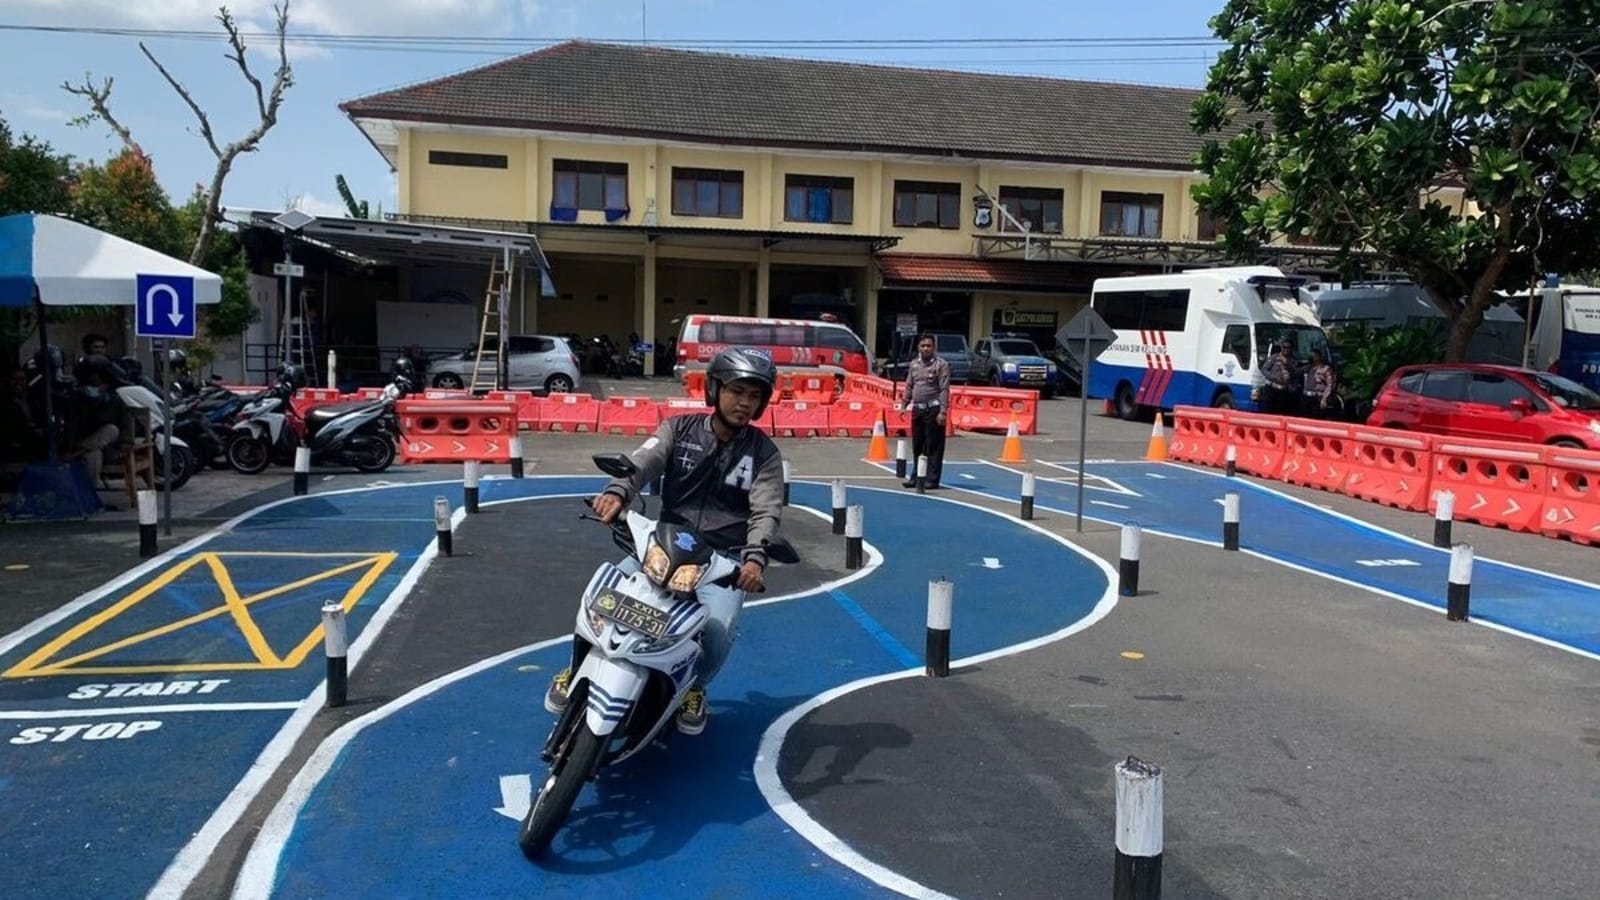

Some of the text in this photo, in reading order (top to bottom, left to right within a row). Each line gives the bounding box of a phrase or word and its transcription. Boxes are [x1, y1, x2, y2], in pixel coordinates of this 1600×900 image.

[632, 601, 662, 618] XXIV
[67, 679, 231, 700] START
[9, 720, 163, 745] STOP
